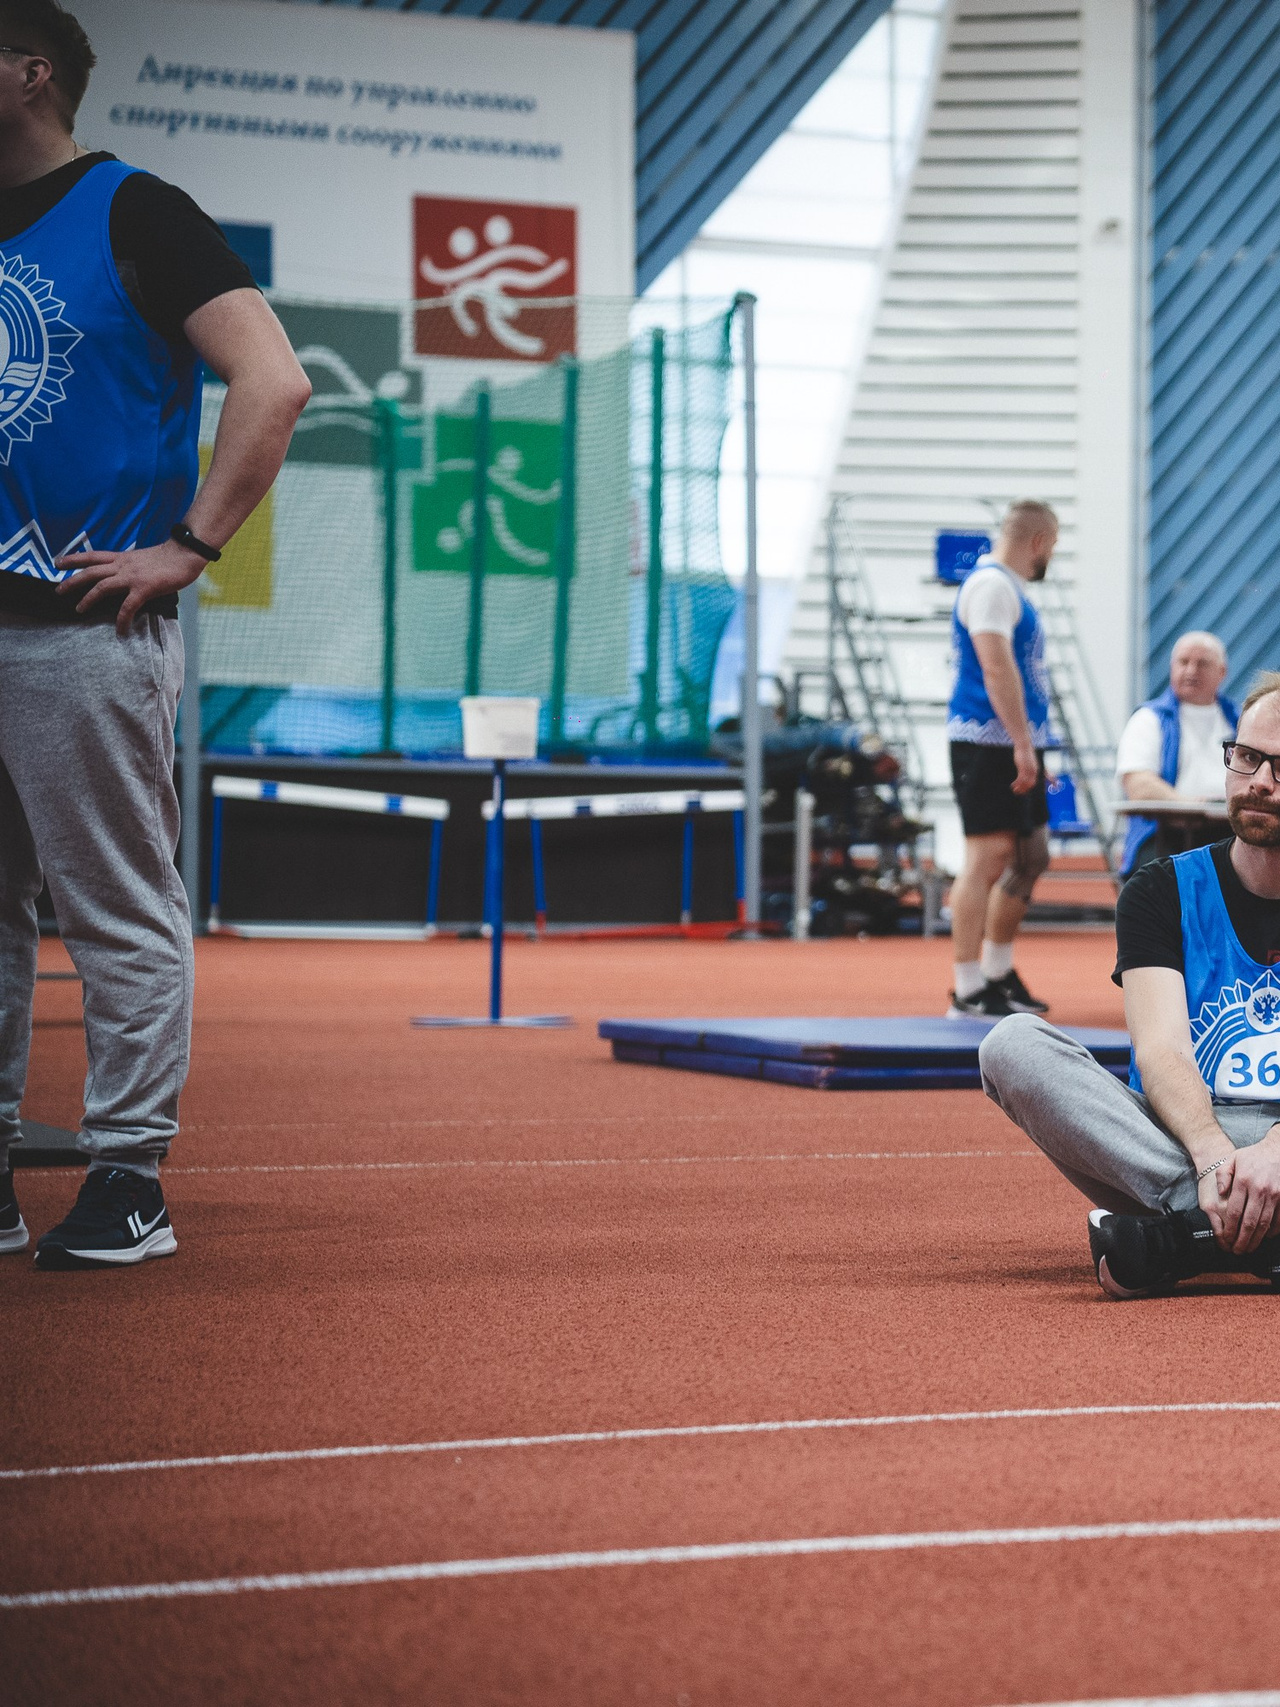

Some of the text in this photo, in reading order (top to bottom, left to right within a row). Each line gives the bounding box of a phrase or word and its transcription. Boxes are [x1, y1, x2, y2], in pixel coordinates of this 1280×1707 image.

[136, 53, 537, 114] Дирекция по управлению
[108, 103, 564, 160] спортивными сооружениями
